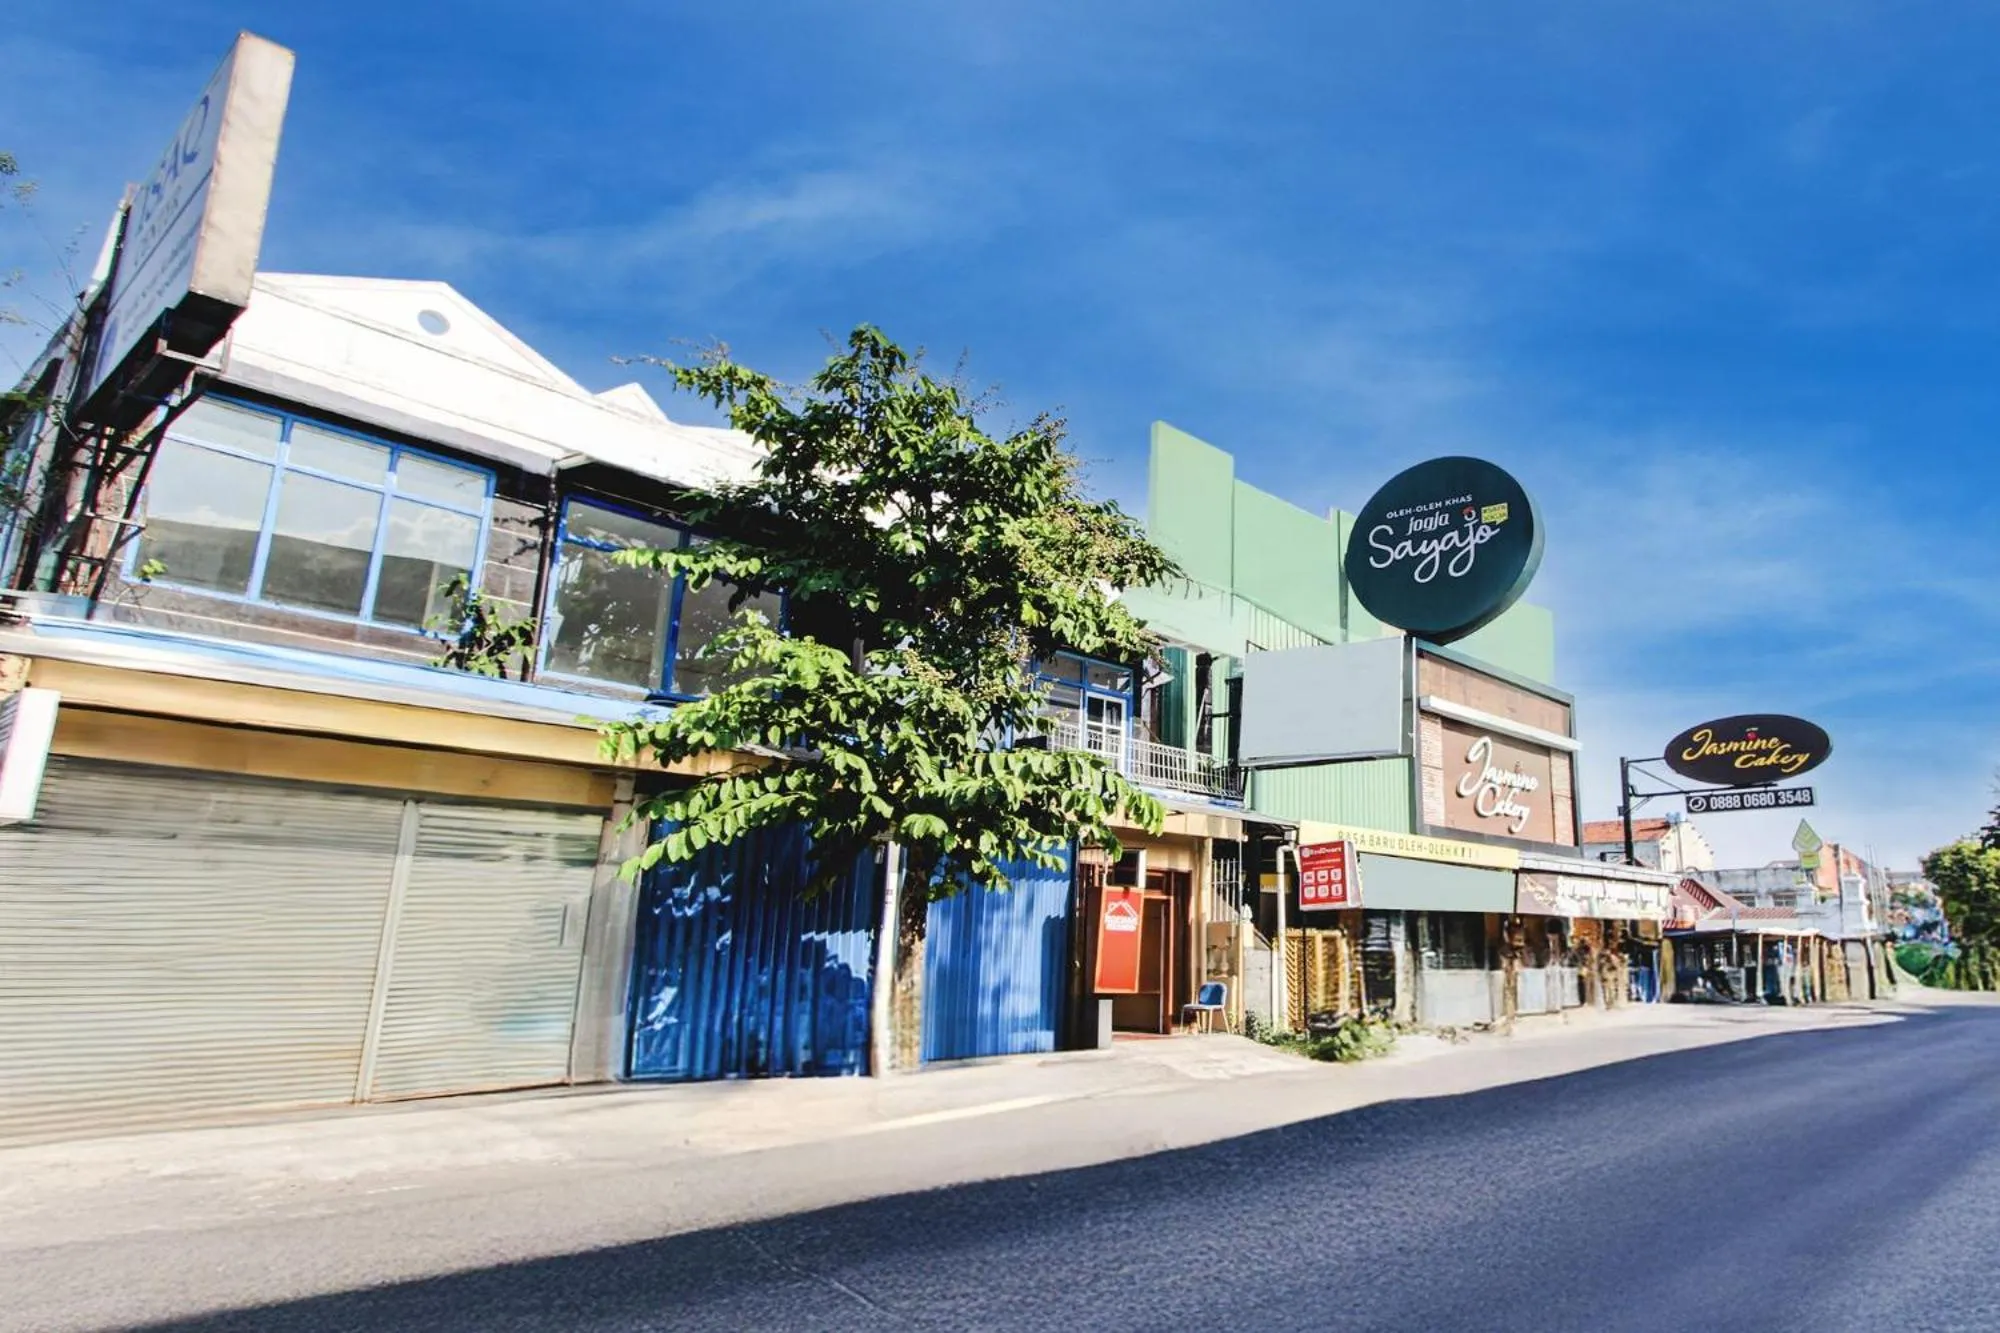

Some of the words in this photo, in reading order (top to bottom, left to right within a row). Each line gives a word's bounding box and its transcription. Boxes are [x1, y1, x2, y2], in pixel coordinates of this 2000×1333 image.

[1386, 501, 1442, 519] OLEH-OLEH
[1445, 494, 1473, 506] KHAS
[1368, 517, 1500, 584] Sayajo
[1682, 728, 1782, 761] Jasmine
[1734, 744, 1812, 773] Cakery
[1459, 736, 1539, 797] Jasmine
[1710, 795, 1741, 810] 0888
[1743, 792, 1775, 807] 0680
[1778, 790, 1811, 806] 3548
[1368, 834, 1396, 849] BARU
[1398, 838, 1453, 856] OLEH-OLEH
